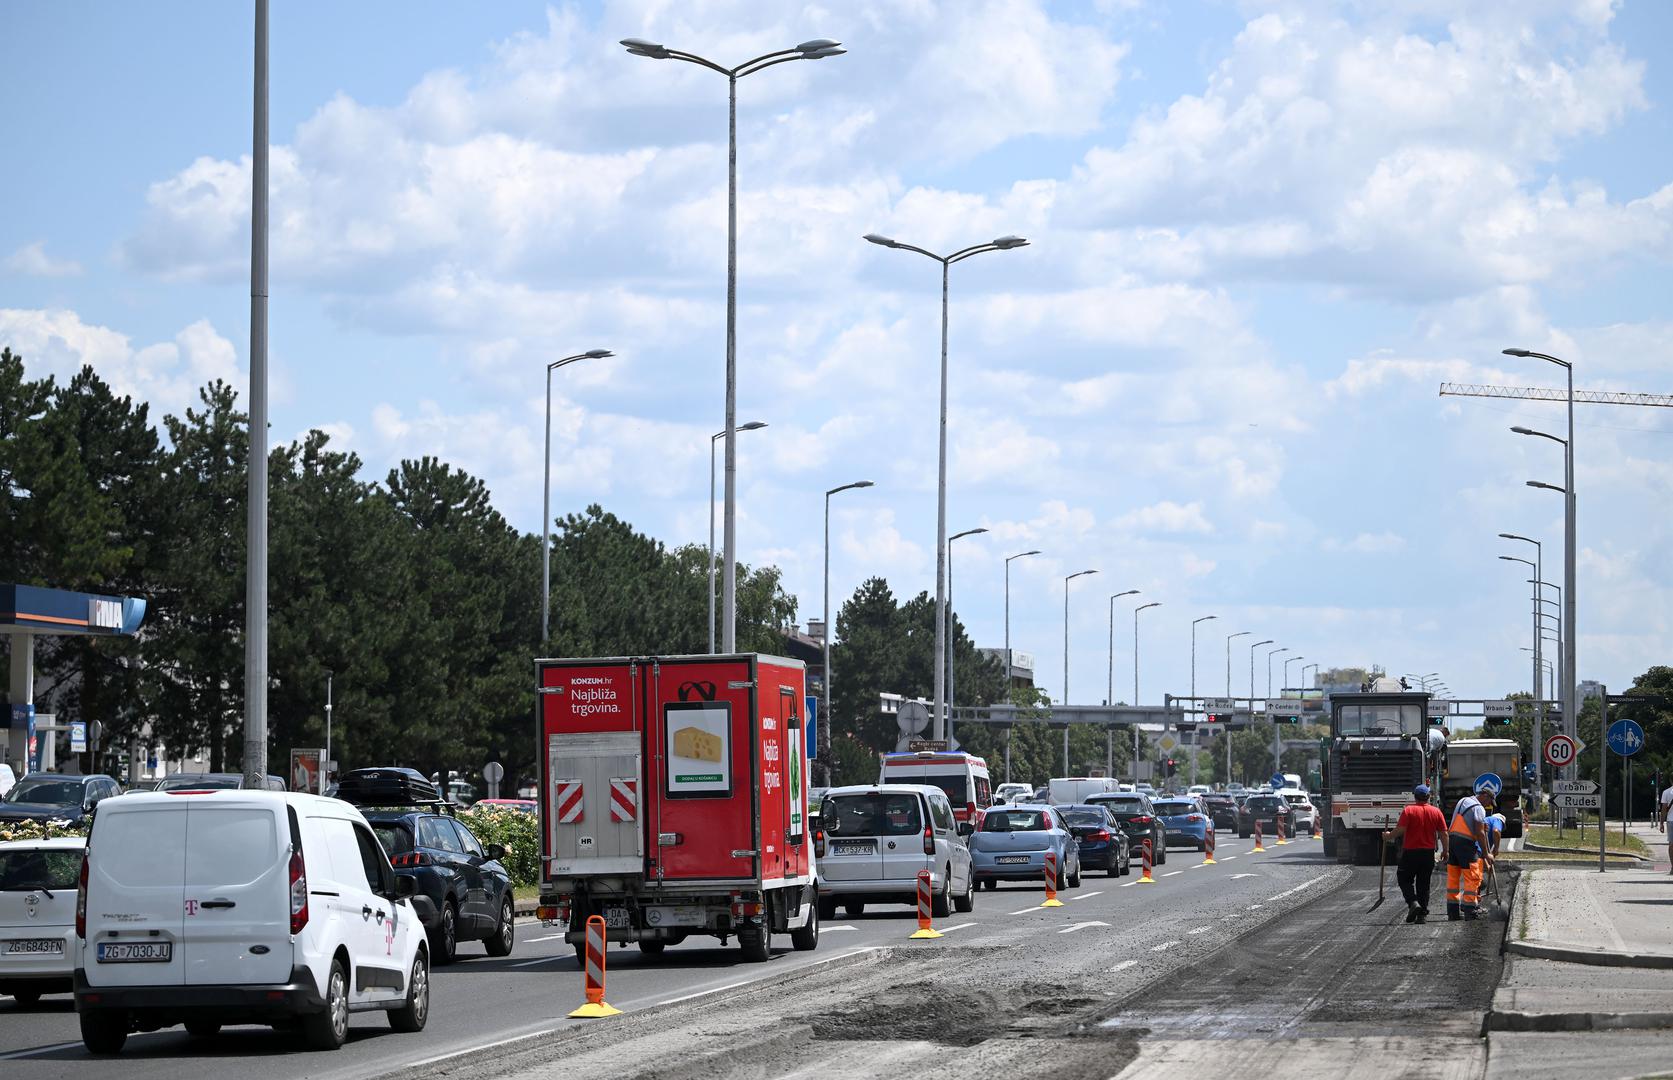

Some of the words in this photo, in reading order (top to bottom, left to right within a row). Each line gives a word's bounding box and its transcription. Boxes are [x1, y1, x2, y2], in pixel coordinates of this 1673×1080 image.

[571, 677, 613, 685] KONZUM.hr
[571, 688, 617, 703] Najbliža
[571, 701, 621, 717] trgovina.
[1551, 743, 1569, 759] 60
[1565, 796, 1597, 806] Rudeš
[185, 899, 198, 915] T
[8, 943, 21, 952] ZG
[105, 946, 120, 958] ZG
[126, 945, 169, 957] 7030-JU
